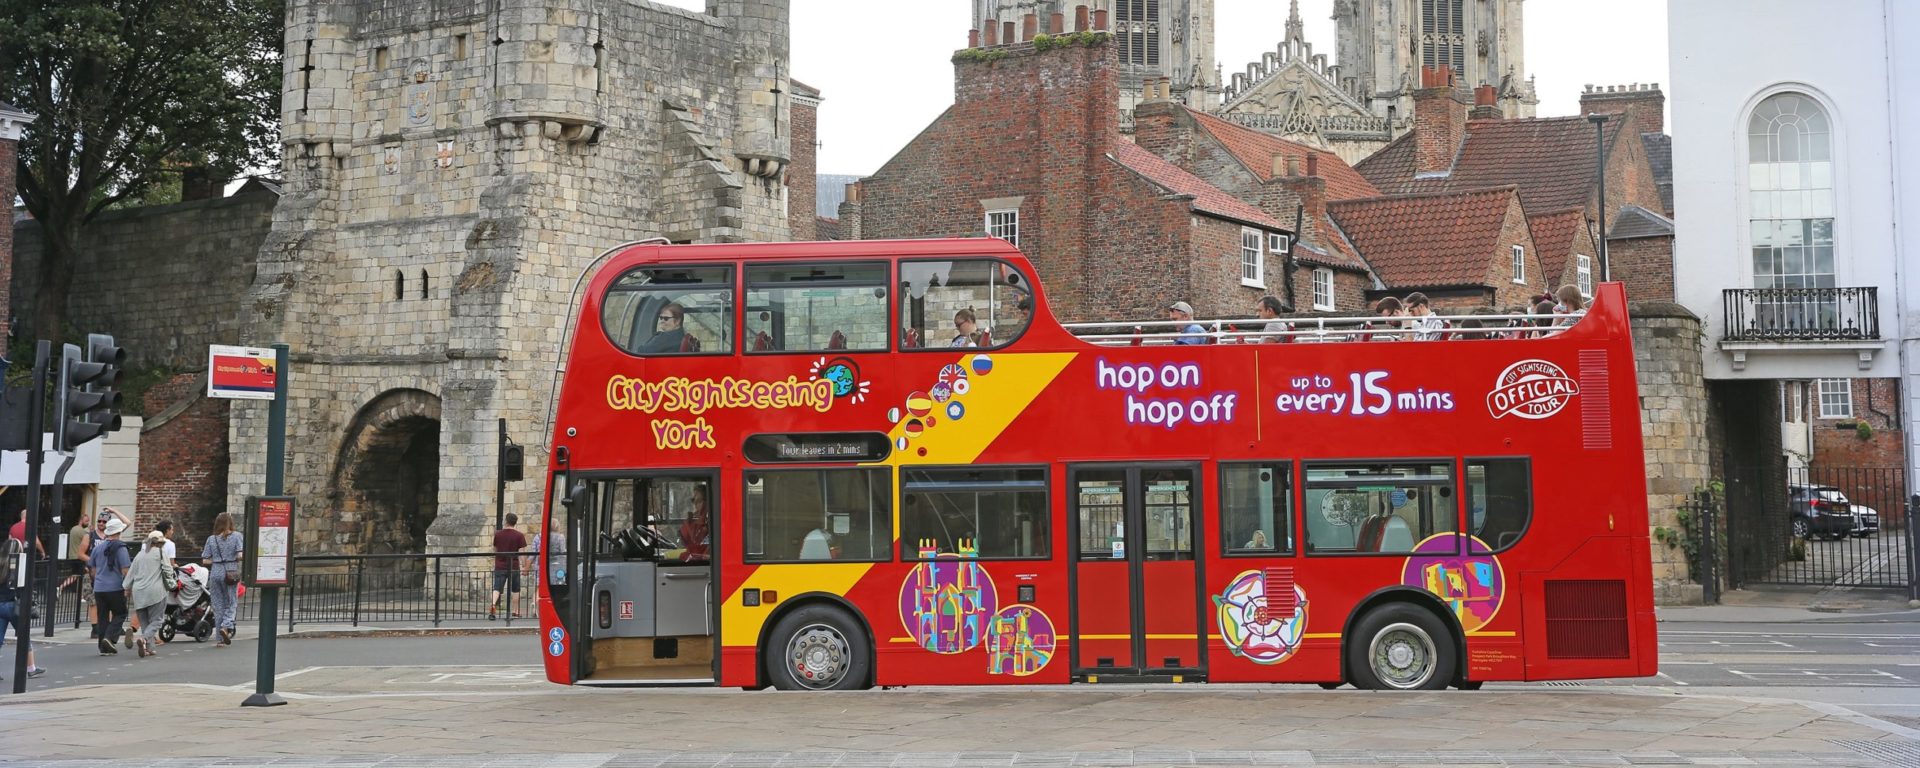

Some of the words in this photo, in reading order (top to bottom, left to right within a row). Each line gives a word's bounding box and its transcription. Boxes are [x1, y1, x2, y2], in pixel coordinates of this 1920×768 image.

[1098, 359, 1155, 393] hop
[1160, 365, 1200, 387] on
[1291, 377, 1310, 390] up
[1314, 375, 1331, 388] to
[1505, 370, 1518, 384] CITY
[1517, 363, 1558, 377] SIGHTSEEING
[1276, 392, 1347, 414] every
[1349, 371, 1392, 415] 15
[1397, 388, 1454, 410] mins
[1494, 379, 1576, 411] OFFICIAL
[1528, 397, 1561, 415] TOUR
[1127, 395, 1184, 428] hop
[1190, 394, 1236, 423] off
[781, 443, 799, 456] Tour
[801, 443, 826, 455] leaves
[827, 444, 835, 455] in
[836, 443, 841, 454] 2
[842, 443, 861, 454] mins
